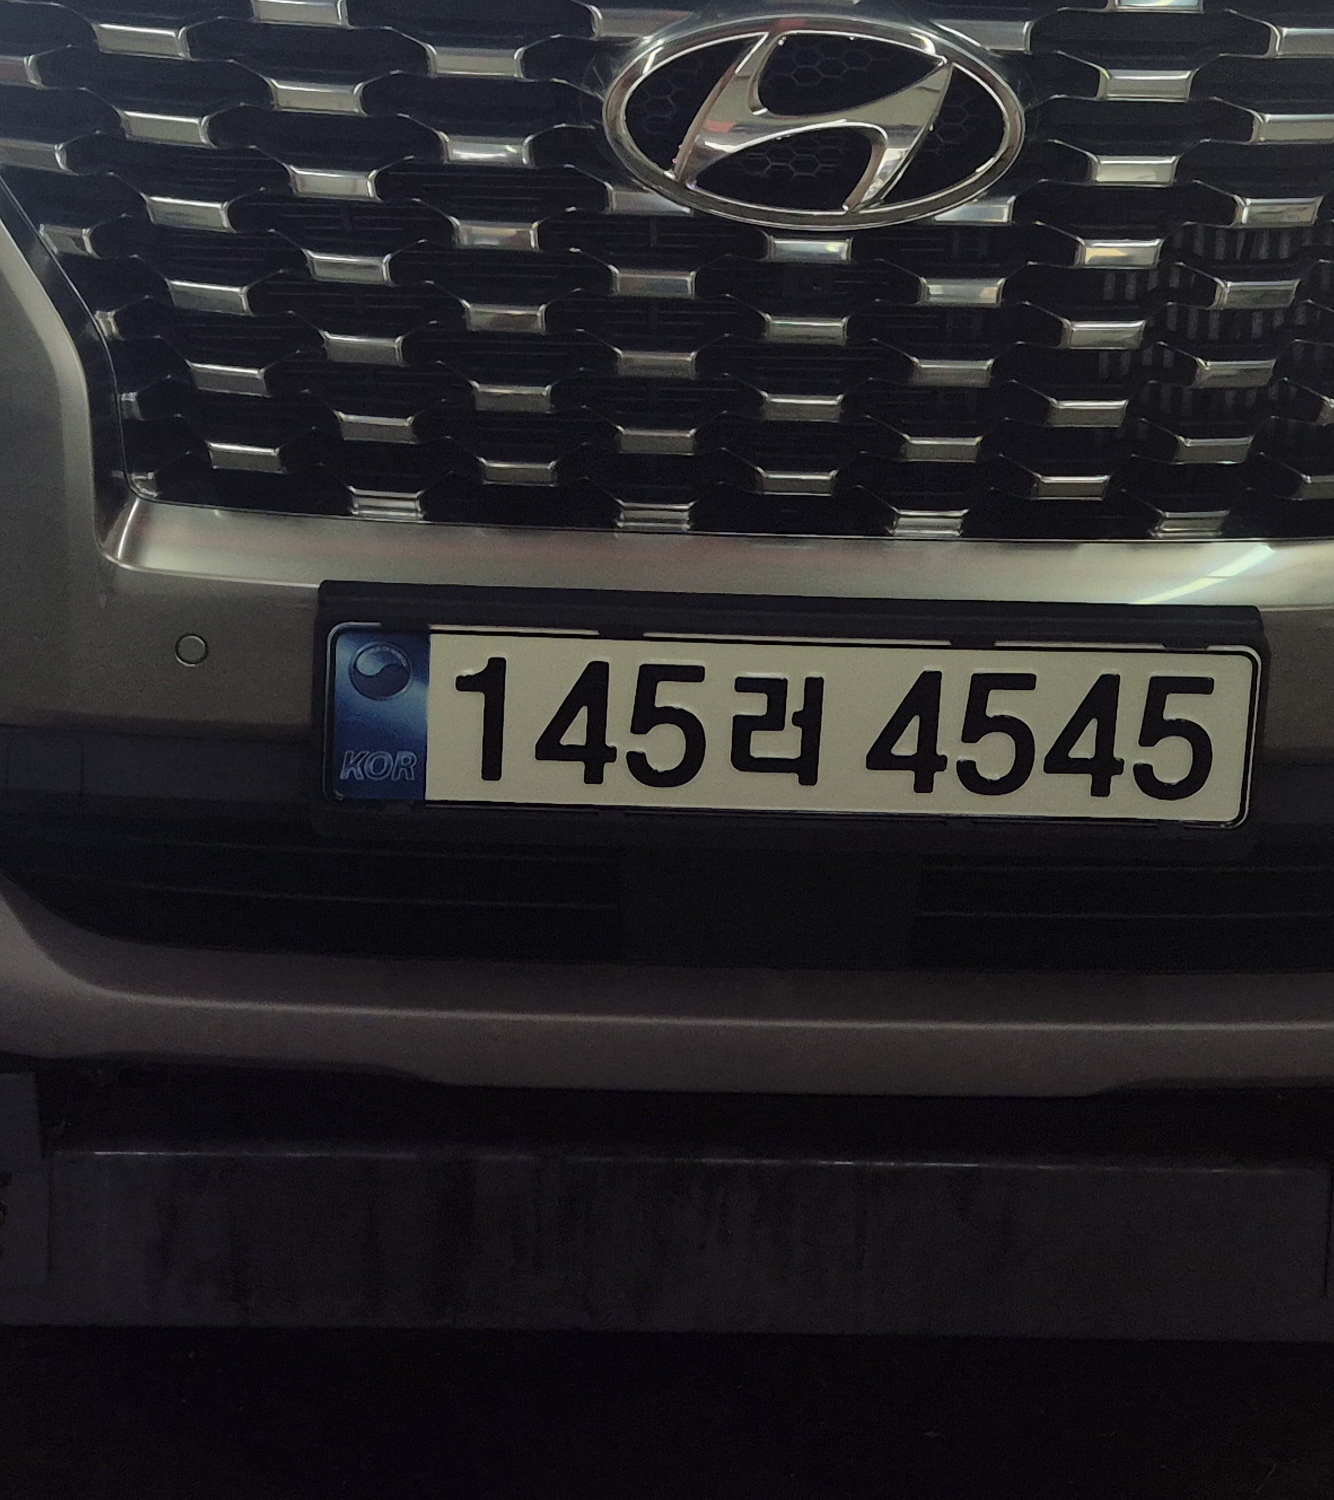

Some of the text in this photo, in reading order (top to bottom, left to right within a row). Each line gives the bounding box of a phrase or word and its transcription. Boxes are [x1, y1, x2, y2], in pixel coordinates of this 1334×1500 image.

[339, 750, 416, 781] KOR
[455, 656, 1216, 801] 145러 4545
